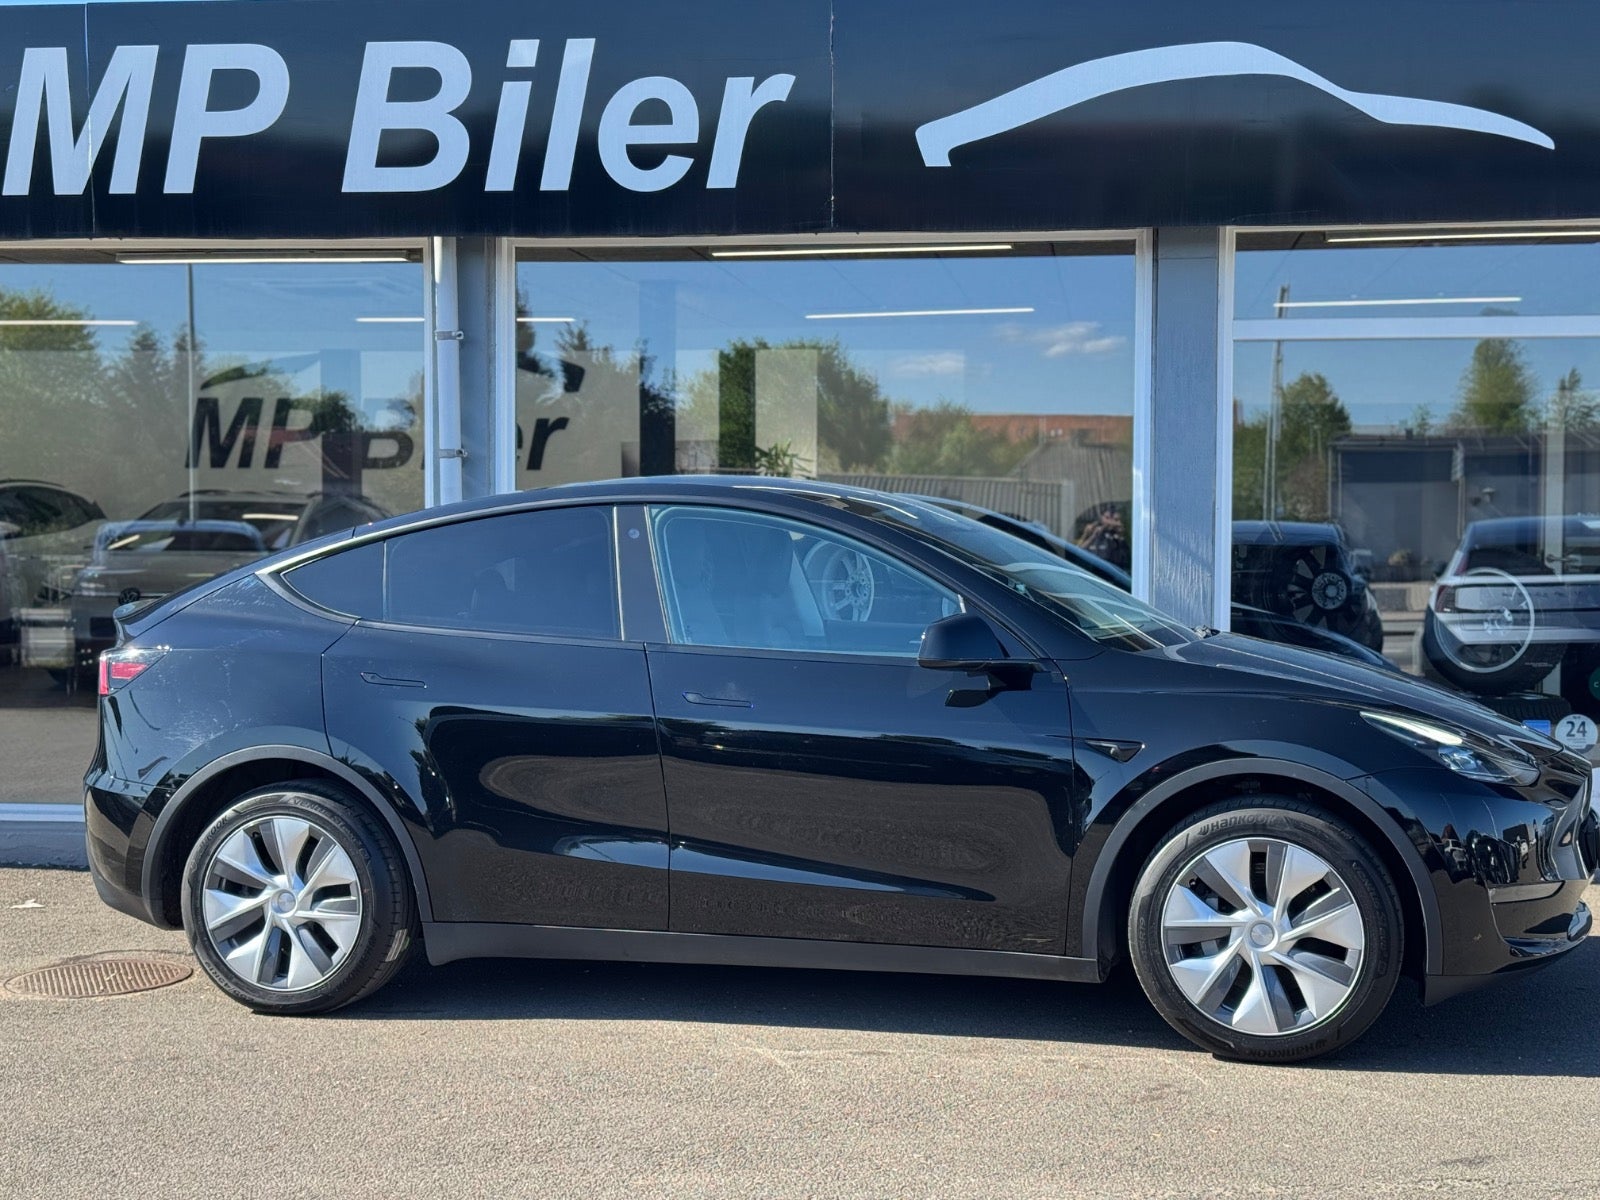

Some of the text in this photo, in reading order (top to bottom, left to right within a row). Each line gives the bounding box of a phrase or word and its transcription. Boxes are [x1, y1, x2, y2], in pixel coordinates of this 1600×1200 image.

[2, 38, 797, 195] MP Biler
[184, 398, 317, 469] MP
[1566, 720, 1587, 737] 24
